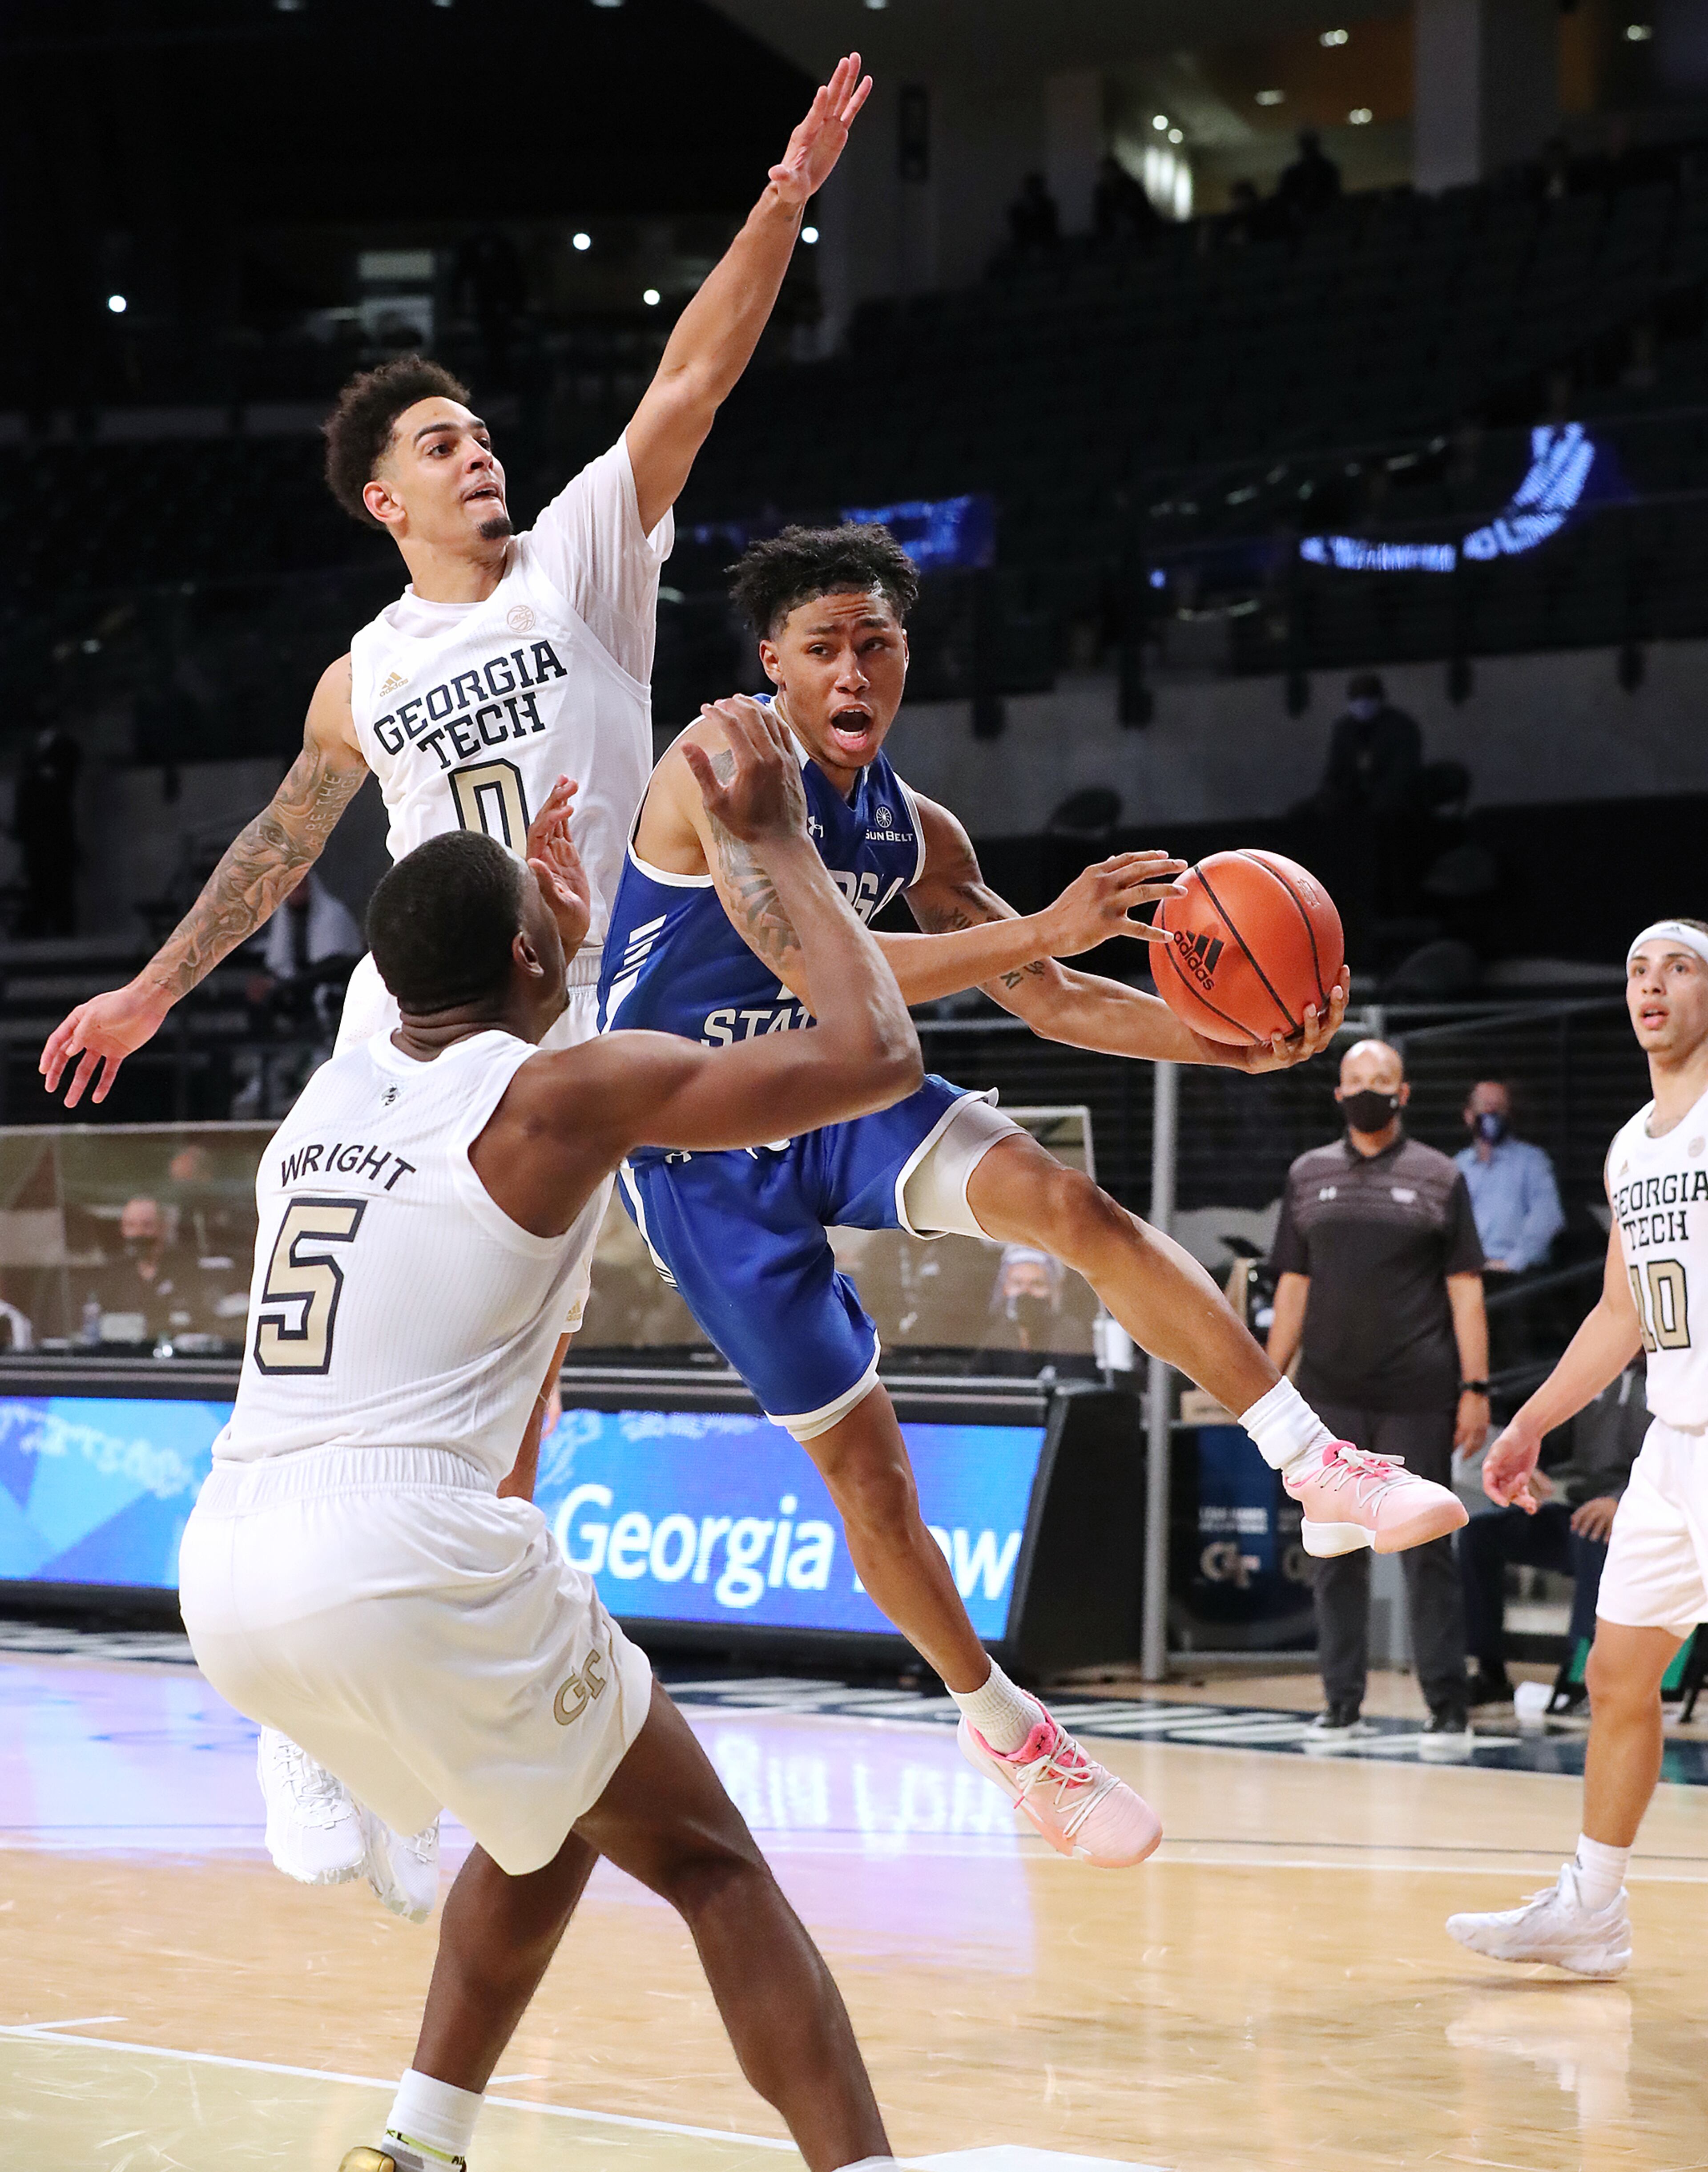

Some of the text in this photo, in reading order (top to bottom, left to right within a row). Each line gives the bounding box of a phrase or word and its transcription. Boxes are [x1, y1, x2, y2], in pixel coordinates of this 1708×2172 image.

[374, 640, 567, 755] GEORGIA
[379, 678, 409, 698] adidas
[416, 692, 546, 770] TECH
[315, 773, 342, 806] THE
[448, 758, 530, 859] 0
[885, 830, 913, 842] BELT
[1174, 930, 1215, 991] adidas
[281, 1143, 416, 1191] WRIGHT
[1623, 1210, 1689, 1251] TECH
[254, 1198, 368, 1375] 5
[1629, 1259, 1692, 1352] 10
[554, 1483, 836, 1609] Georgia
